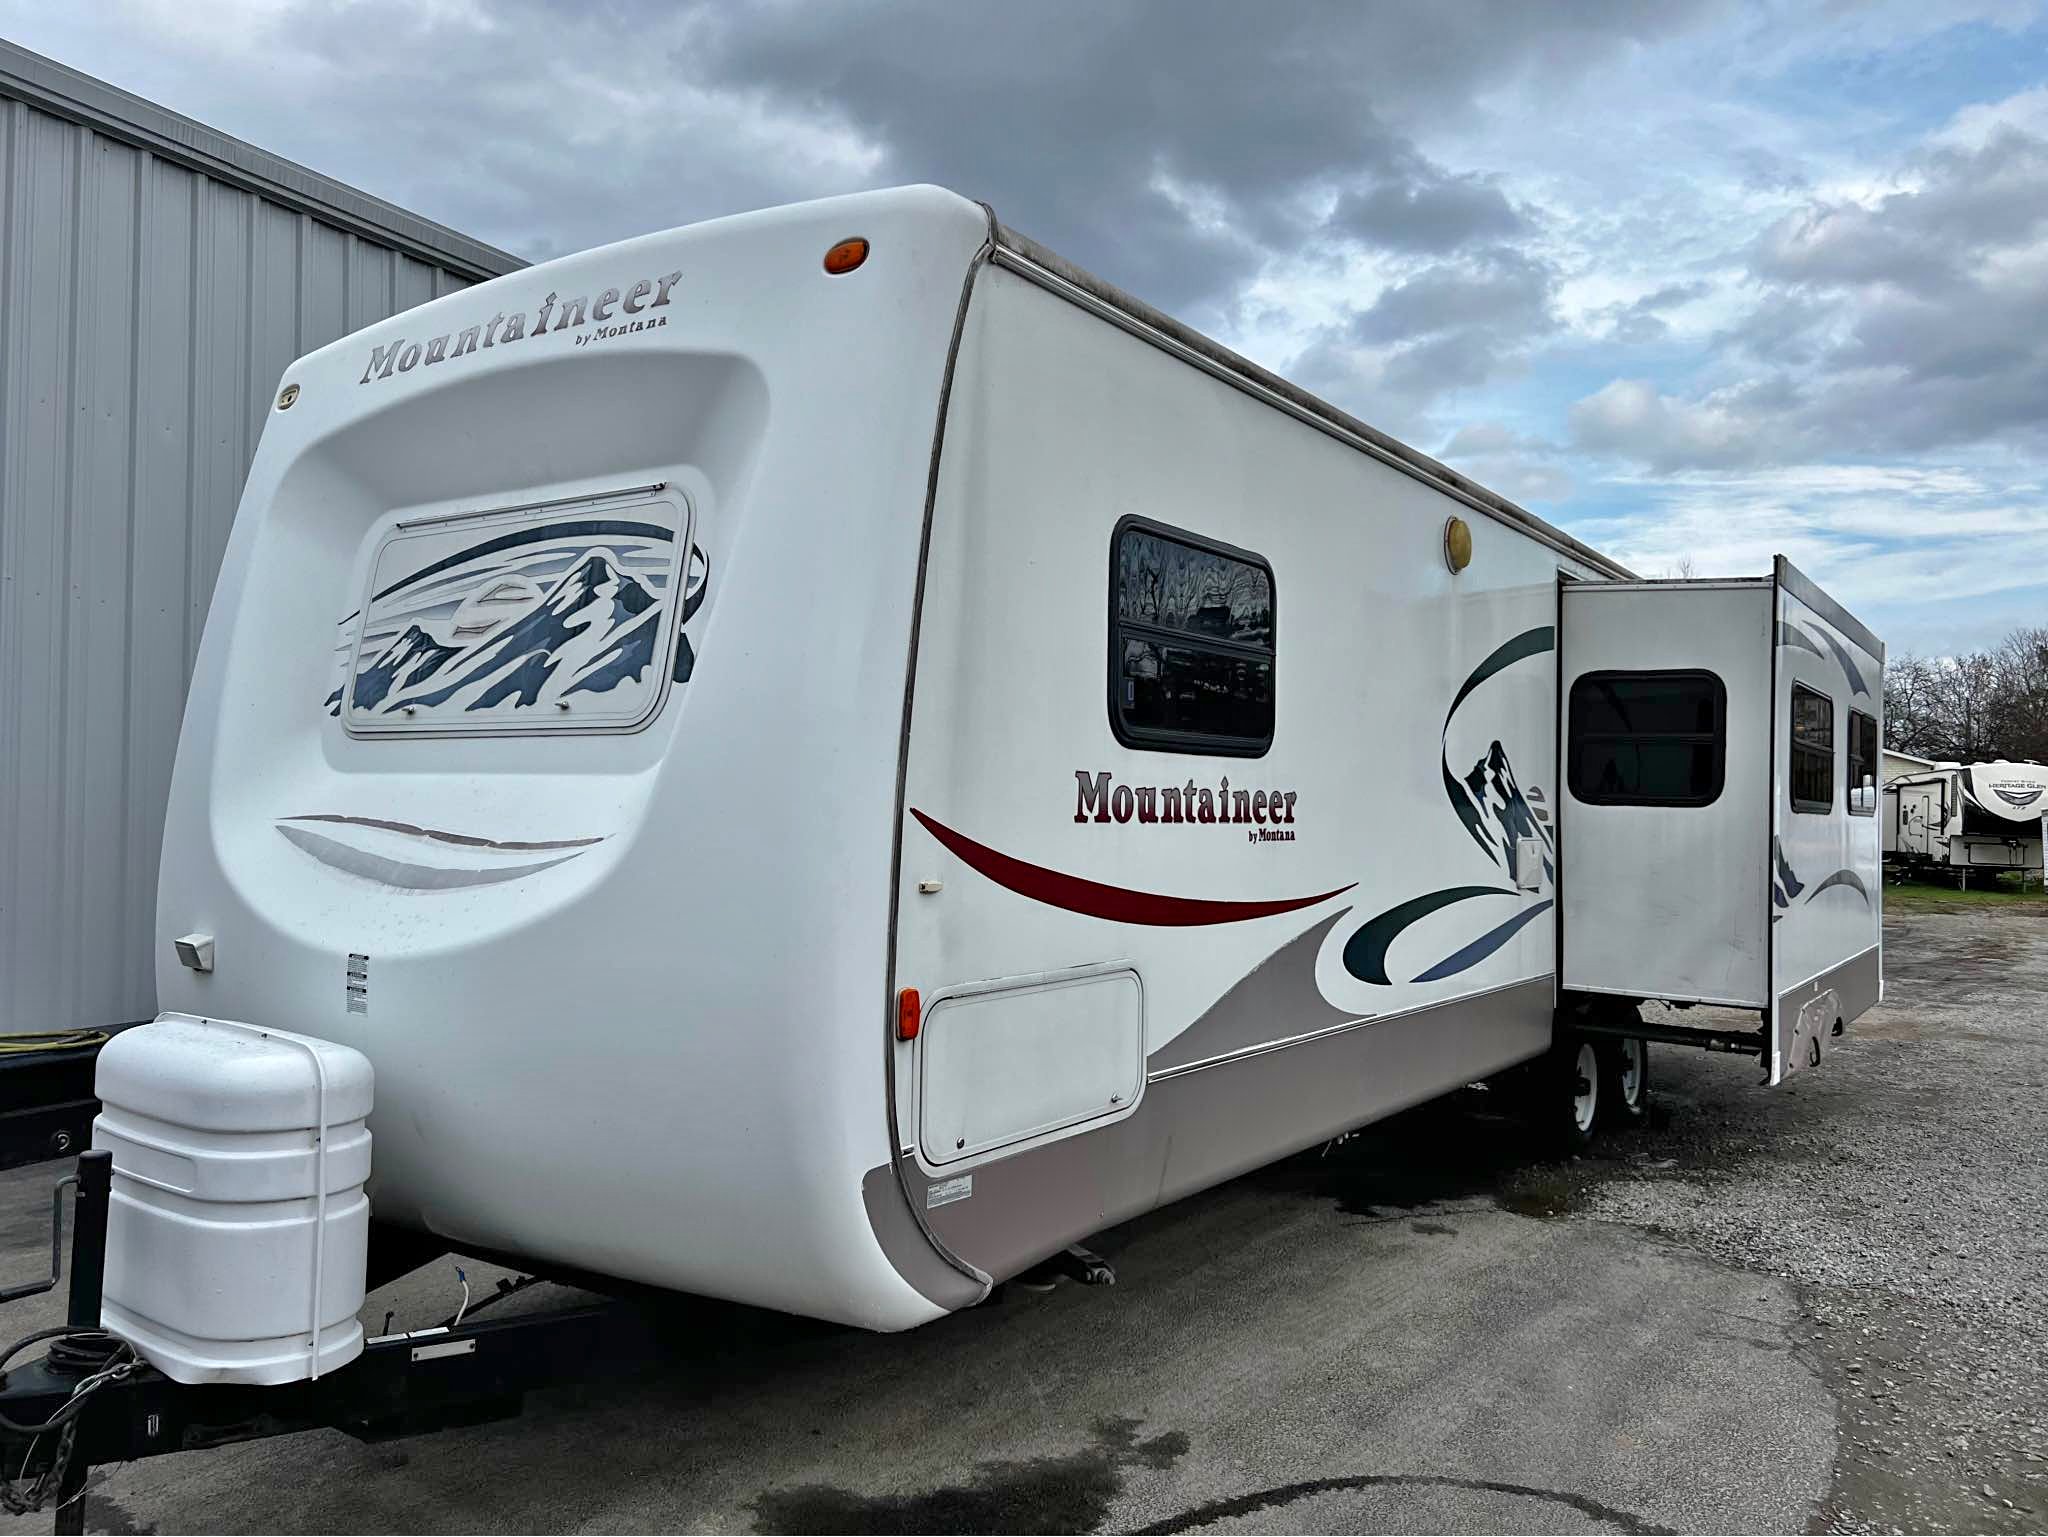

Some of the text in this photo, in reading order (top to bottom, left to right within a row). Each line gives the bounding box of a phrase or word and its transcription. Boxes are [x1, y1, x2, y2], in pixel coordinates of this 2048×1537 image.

[359, 270, 683, 385] Mountaineer
[575, 315, 668, 346] by Montana
[1074, 770, 1297, 824] Mountaineer
[1249, 828, 1296, 844] by Montana
